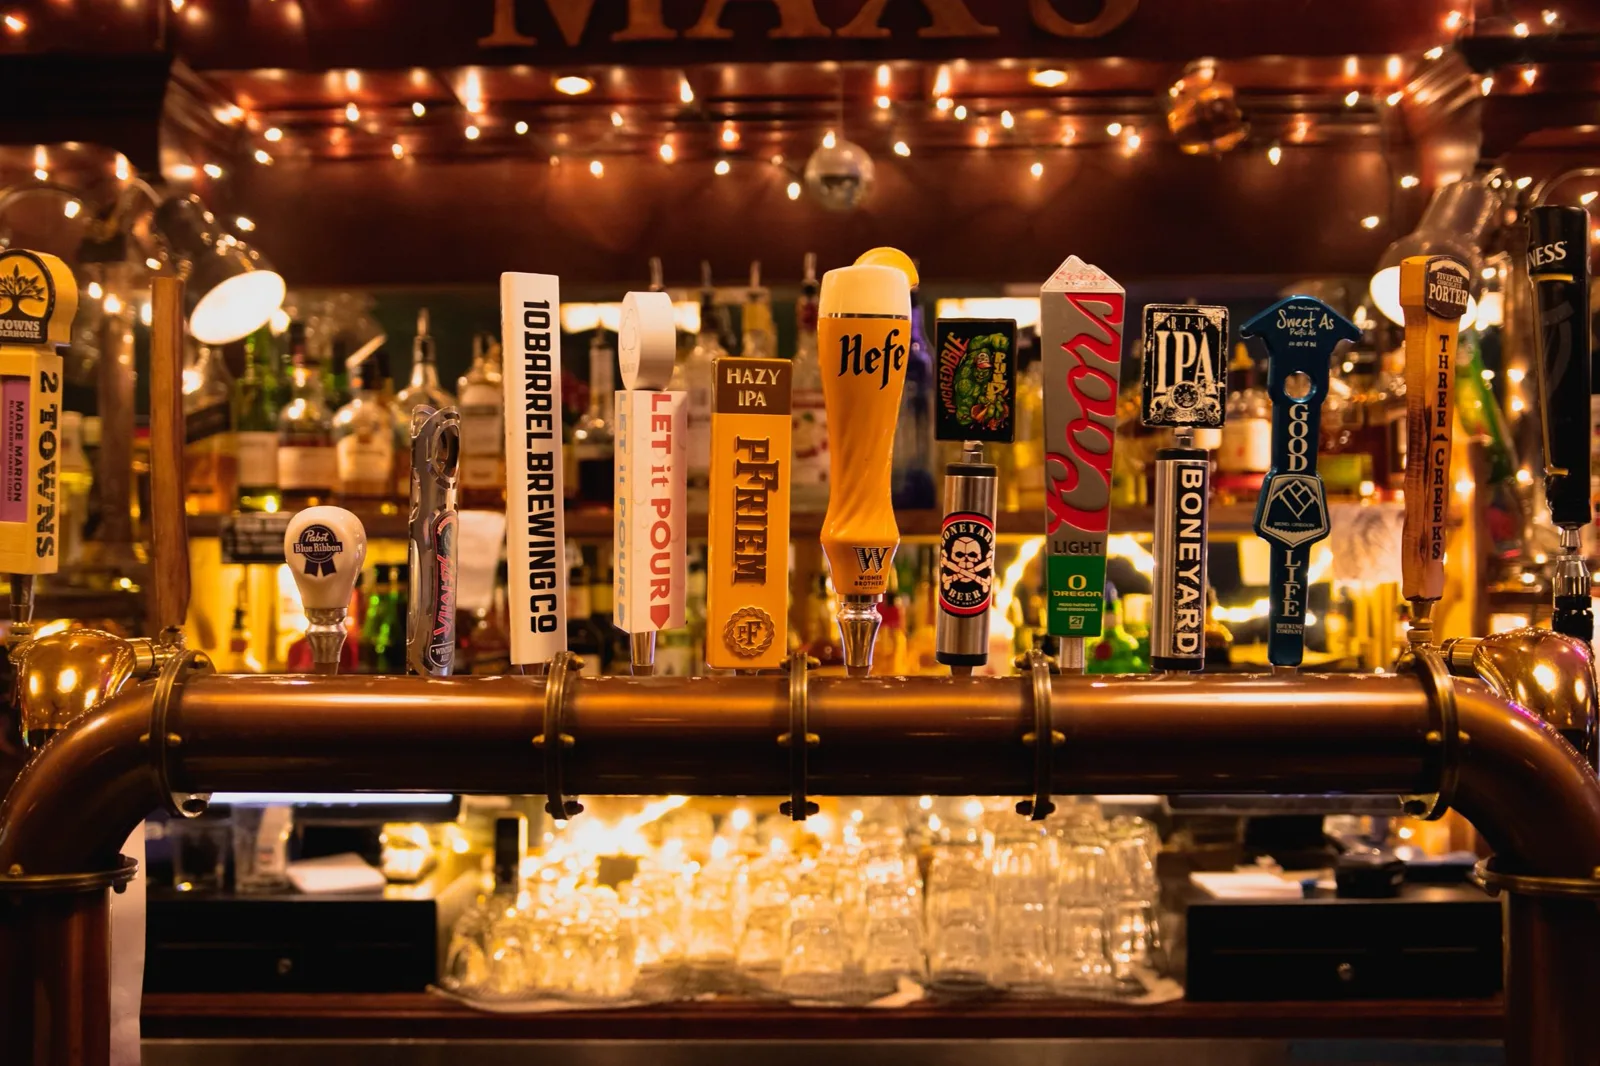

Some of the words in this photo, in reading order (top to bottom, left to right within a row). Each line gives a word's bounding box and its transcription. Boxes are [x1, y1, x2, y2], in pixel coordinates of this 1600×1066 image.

[1429, 283, 1468, 306] PORTER
[1276, 309, 1316, 329] Sweet
[1318, 313, 1335, 330] As
[40, 371, 59, 393] 2
[726, 368, 781, 385] HAZY
[838, 329, 905, 390] Hefe
[940, 331, 970, 414] INCREDIBLE
[1155, 330, 1217, 395] IPA
[1438, 335, 1449, 428] THREE
[15, 401, 25, 441] MADE
[738, 390, 767, 407] IPA
[1046, 293, 1124, 535] Coors
[651, 394, 671, 454] LET
[1287, 404, 1310, 471] GOOD
[13, 446, 23, 502] MARION
[36, 404, 58, 558] TOWNS
[651, 464, 671, 487] it
[1431, 448, 1445, 560] CREEKS
[294, 543, 313, 553] Blue
[313, 543, 341, 552] Ribbon
[305, 530, 329, 542] Pabst
[650, 498, 671, 602] POUR
[852, 546, 891, 573] W
[1053, 541, 1102, 555] LIGHT
[1067, 574, 1087, 590] O
[1177, 469, 1203, 653] BONEYARD
[1282, 550, 1301, 617] LIFE
[948, 588, 981, 601] BEER
